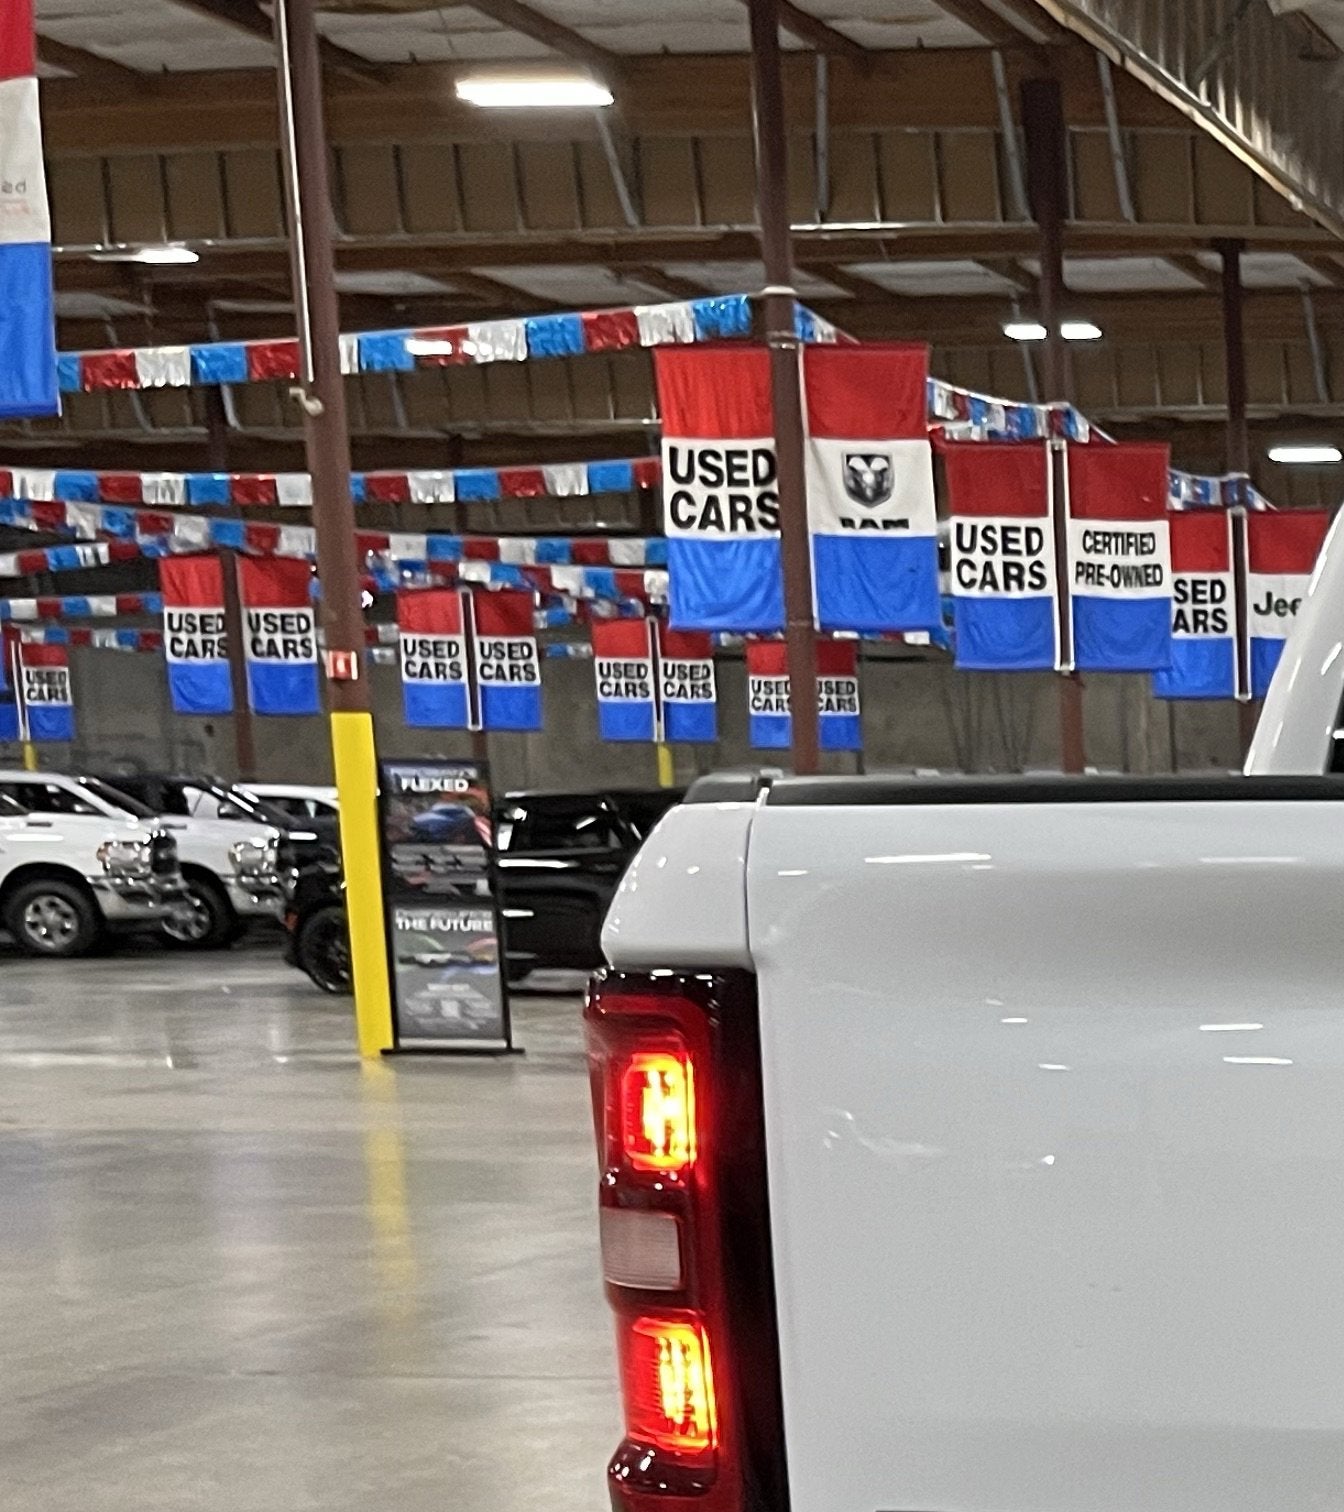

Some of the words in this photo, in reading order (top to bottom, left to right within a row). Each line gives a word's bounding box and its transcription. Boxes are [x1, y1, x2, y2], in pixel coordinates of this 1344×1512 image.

[668, 446, 778, 488] USED
[670, 490, 780, 532] CARS
[955, 522, 1044, 557] USED
[1082, 529, 1156, 556] CERTIFIED
[955, 558, 1048, 592] CARS
[1074, 561, 1164, 588] PRE-OWNED
[1173, 578, 1227, 605] SED
[167, 612, 226, 634] USED
[248, 612, 311, 634] USED
[1172, 607, 1229, 634] ARS
[250, 637, 313, 659] CARS
[402, 638, 460, 660] USED
[479, 640, 533, 661] USED
[26, 670, 67, 686] USED
[404, 661, 463, 681] CARS
[478, 661, 537, 682] CARS
[598, 661, 648, 680] USED
[663, 661, 711, 680] USED
[599, 681, 650, 699] CARS
[664, 681, 712, 699] CARS
[751, 696, 791, 712] CAR
[818, 696, 857, 712] ARS
